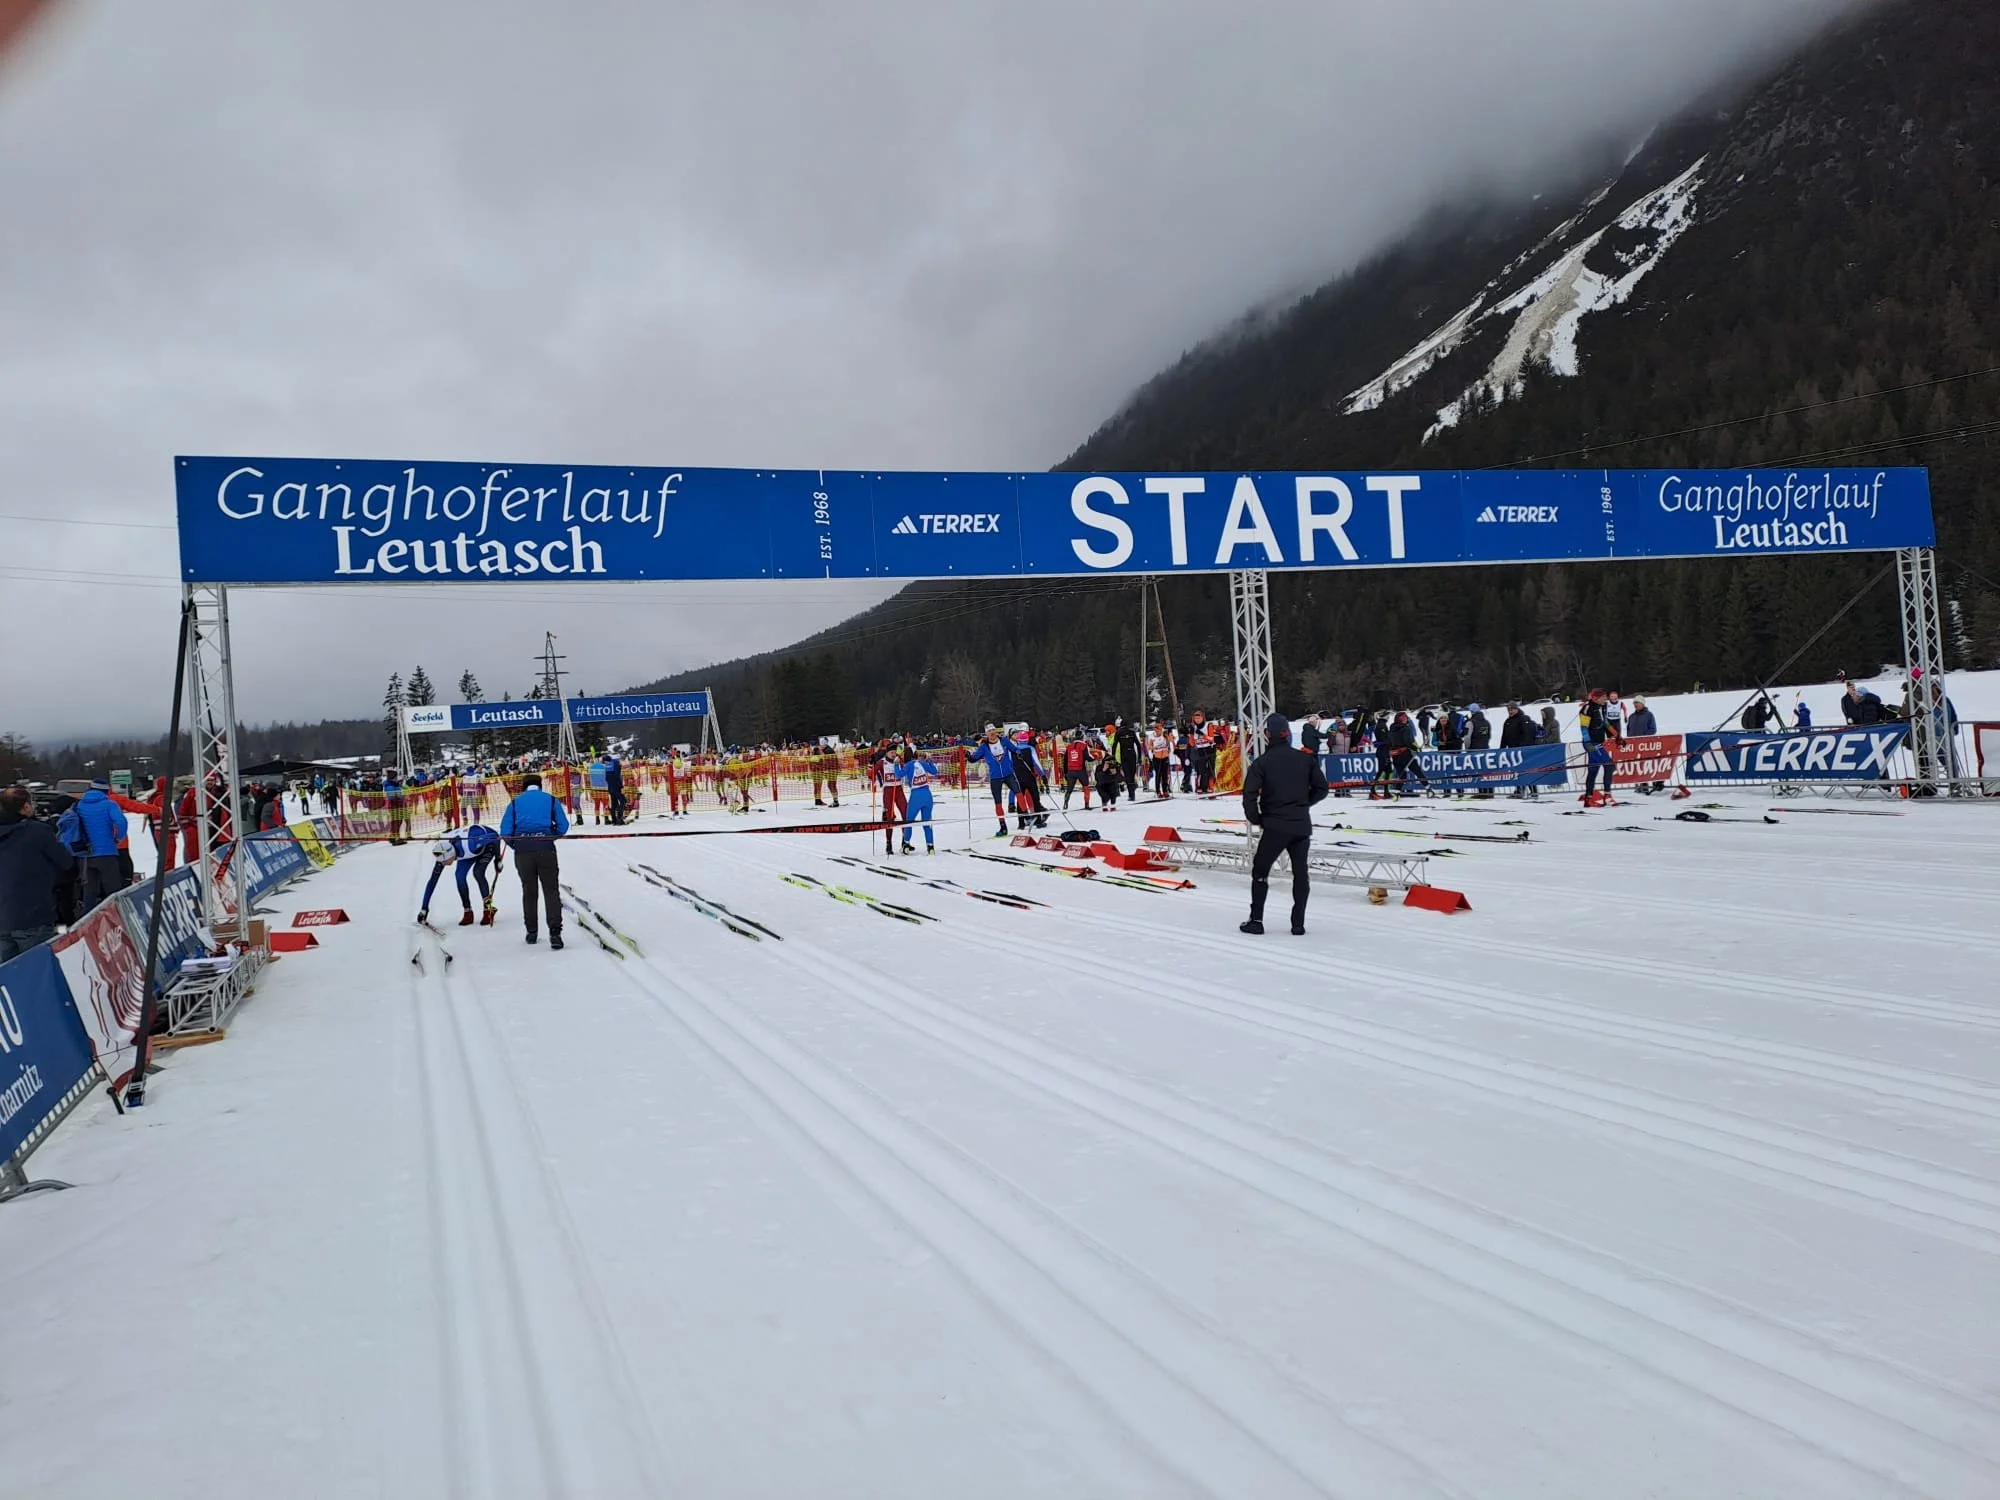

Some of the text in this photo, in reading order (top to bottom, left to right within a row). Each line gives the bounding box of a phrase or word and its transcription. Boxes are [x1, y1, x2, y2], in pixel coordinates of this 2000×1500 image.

[217, 467, 683, 538] Ganghoferlauf
[1498, 505, 1559, 523] TERREX
[1601, 486, 1615, 542] EST. 1968
[1659, 472, 1886, 521] Ganghoferlauf
[813, 491, 833, 560] EST. 1968
[919, 513, 1000, 534] TERREX
[1071, 475, 1421, 569] START
[1714, 510, 1849, 549] Leutasch
[331, 525, 607, 576] Leutasch
[411, 712, 444, 722] Seefeld
[470, 705, 543, 724] Leutasch
[575, 700, 701, 718] #tirolshochplateau
[1638, 742, 1662, 752] CLUB
[1738, 732, 1899, 772] TERREX
